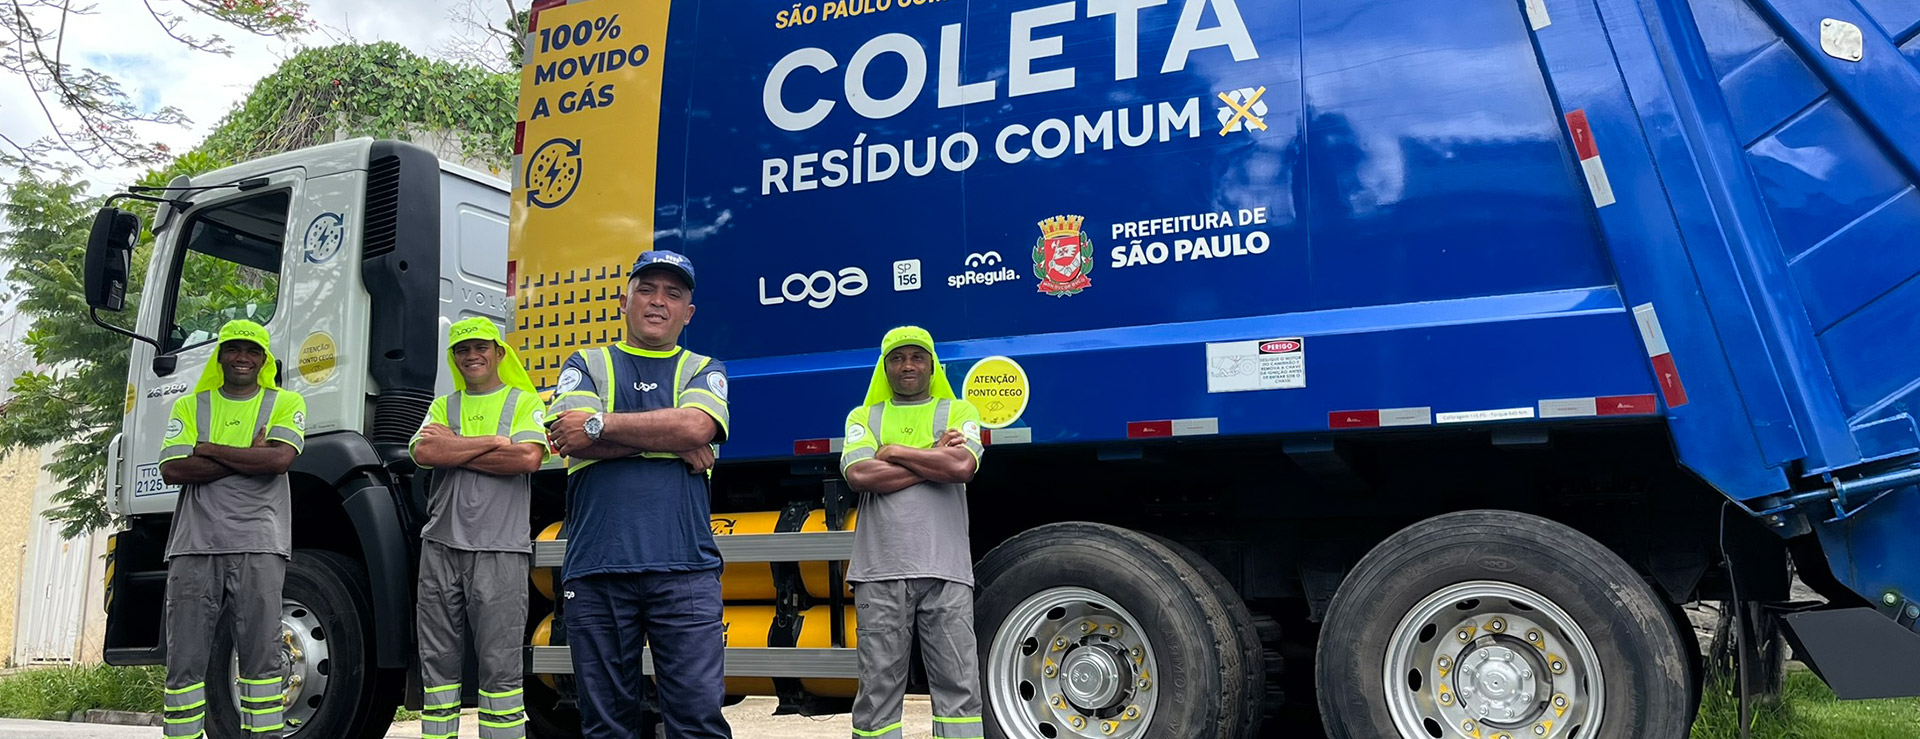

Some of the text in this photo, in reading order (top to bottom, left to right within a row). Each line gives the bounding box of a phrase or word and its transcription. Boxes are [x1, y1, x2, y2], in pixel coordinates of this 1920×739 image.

[775, 0, 892, 29] SÃO PAULO
[540, 13, 621, 53] 100%
[534, 44, 649, 86] MOVIDO
[763, 0, 1259, 131] COLETA
[530, 81, 614, 120] A GÁS
[761, 96, 1200, 195] RESÍDUO COMUM
[1111, 207, 1267, 240] PREFEITURA DE
[1111, 231, 1270, 268] SÃO PAULO
[897, 263, 911, 274] SP
[898, 273, 917, 286] 156
[947, 266, 1020, 288] spRegula.
[299, 353, 334, 365] PONTO CEGO
[303, 343, 331, 354] ATENÇÃO!
[1267, 343, 1293, 351] PERIGO
[973, 373, 1018, 385] ATENÇÃO!
[968, 388, 1023, 397] PONTO CEGO
